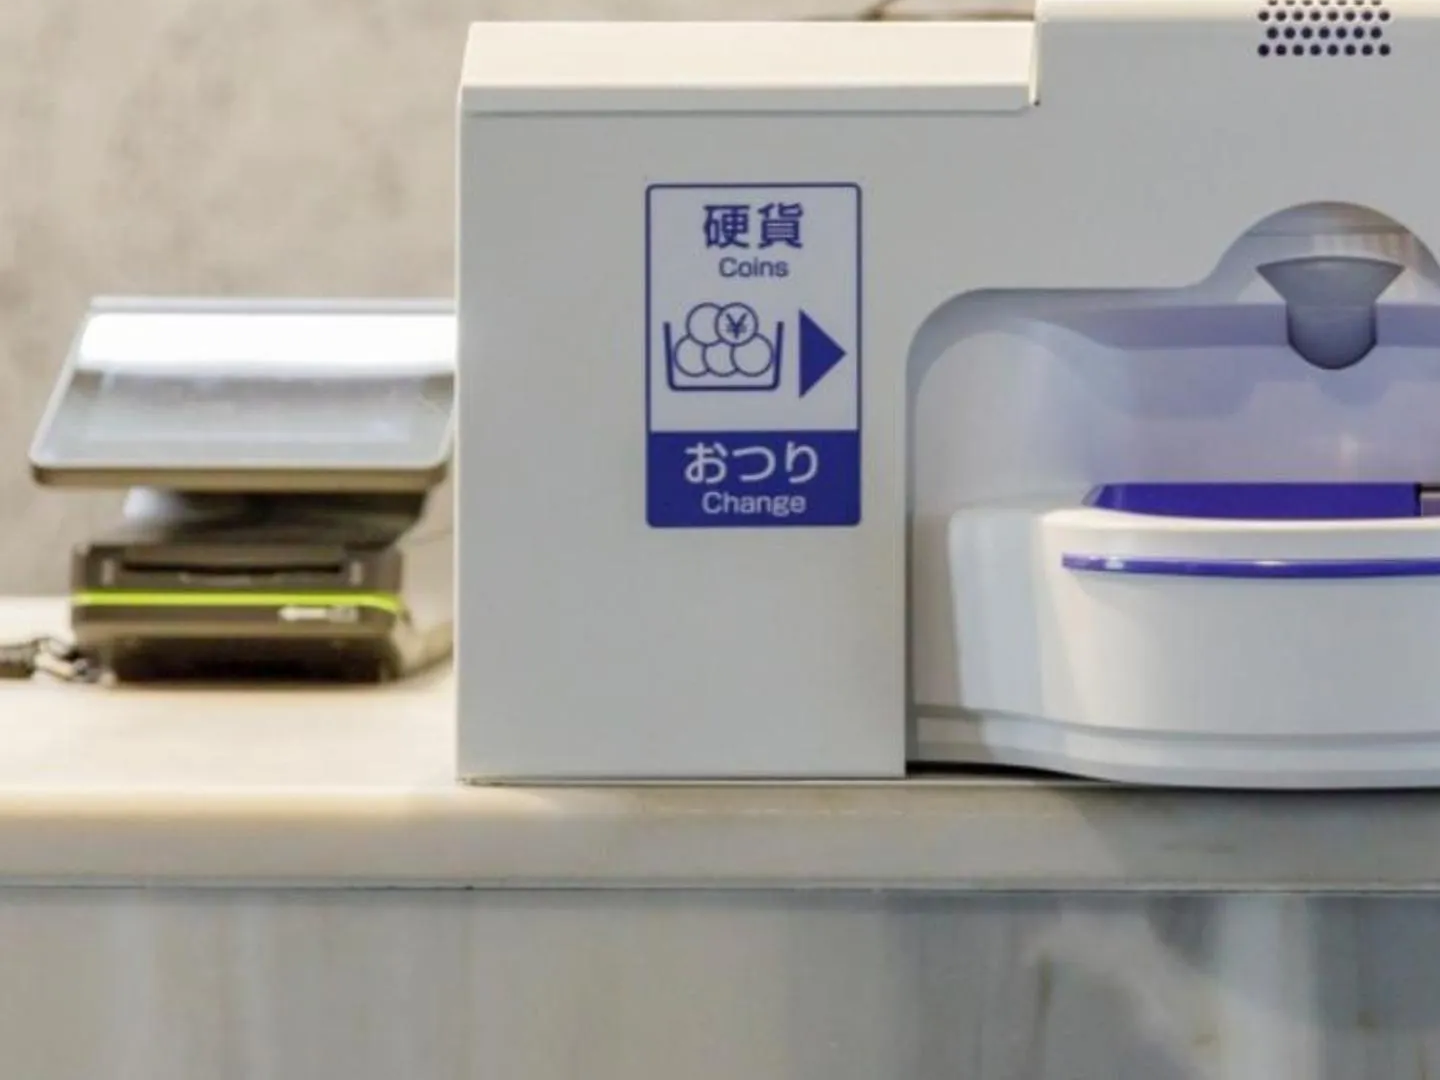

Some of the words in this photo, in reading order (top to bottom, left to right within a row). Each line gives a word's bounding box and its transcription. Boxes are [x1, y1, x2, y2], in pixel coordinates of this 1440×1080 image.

[702, 201, 805, 251] 硬貨
[717, 255, 790, 280] Coins
[683, 441, 819, 485] おつり
[701, 490, 808, 518] Change
